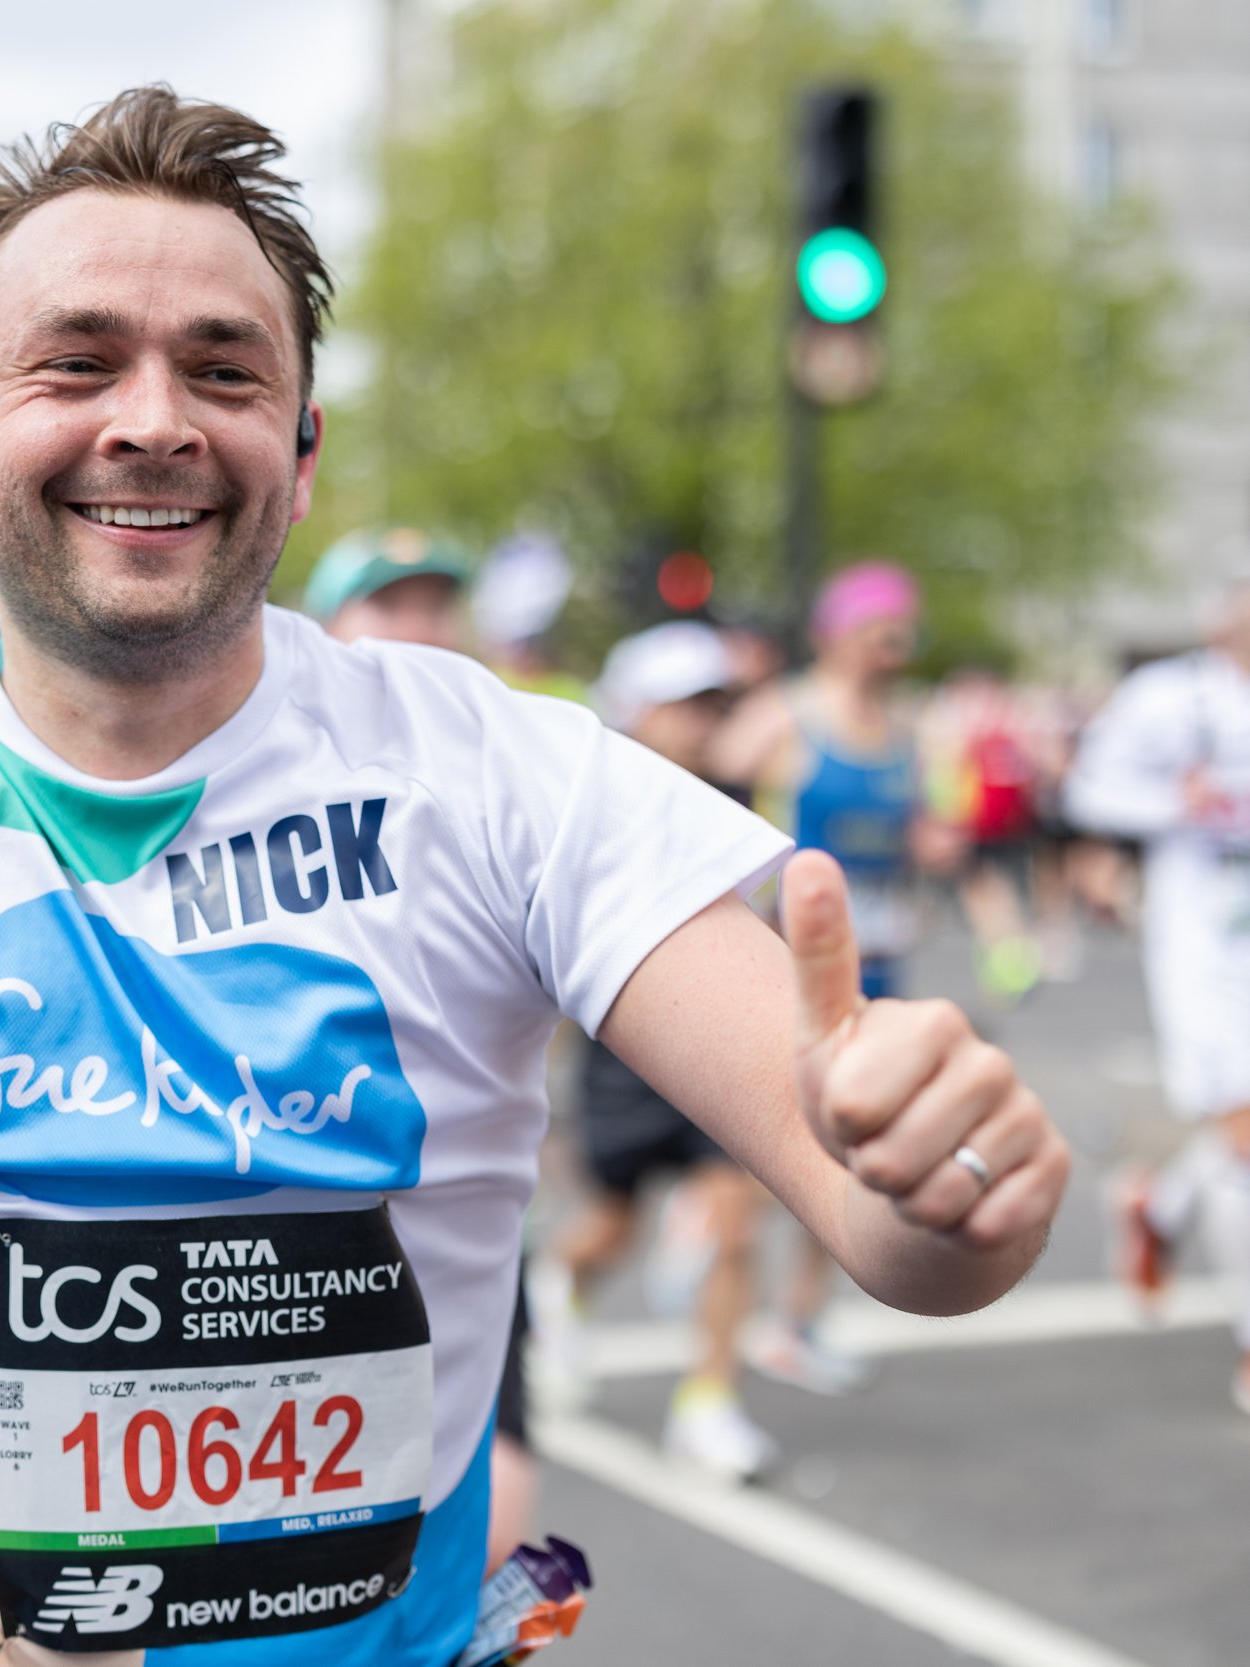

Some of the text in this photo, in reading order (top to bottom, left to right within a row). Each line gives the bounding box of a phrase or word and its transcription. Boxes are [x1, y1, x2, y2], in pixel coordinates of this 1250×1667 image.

[167, 798, 398, 942] NICK
[180, 1239, 279, 1268] TATA
[9, 1243, 162, 1344] tcs
[180, 1262, 403, 1305] CONSULTANCY
[181, 1306, 326, 1340] SERVICES
[150, 1379, 257, 1393] #WeRunTogether
[0, 1421, 31, 1430] WAVE
[62, 1395, 363, 1512] 10642
[281, 1508, 374, 1532] MED, RELAXED
[77, 1534, 126, 1547] MEDAL
[166, 1574, 384, 1628] new balance
